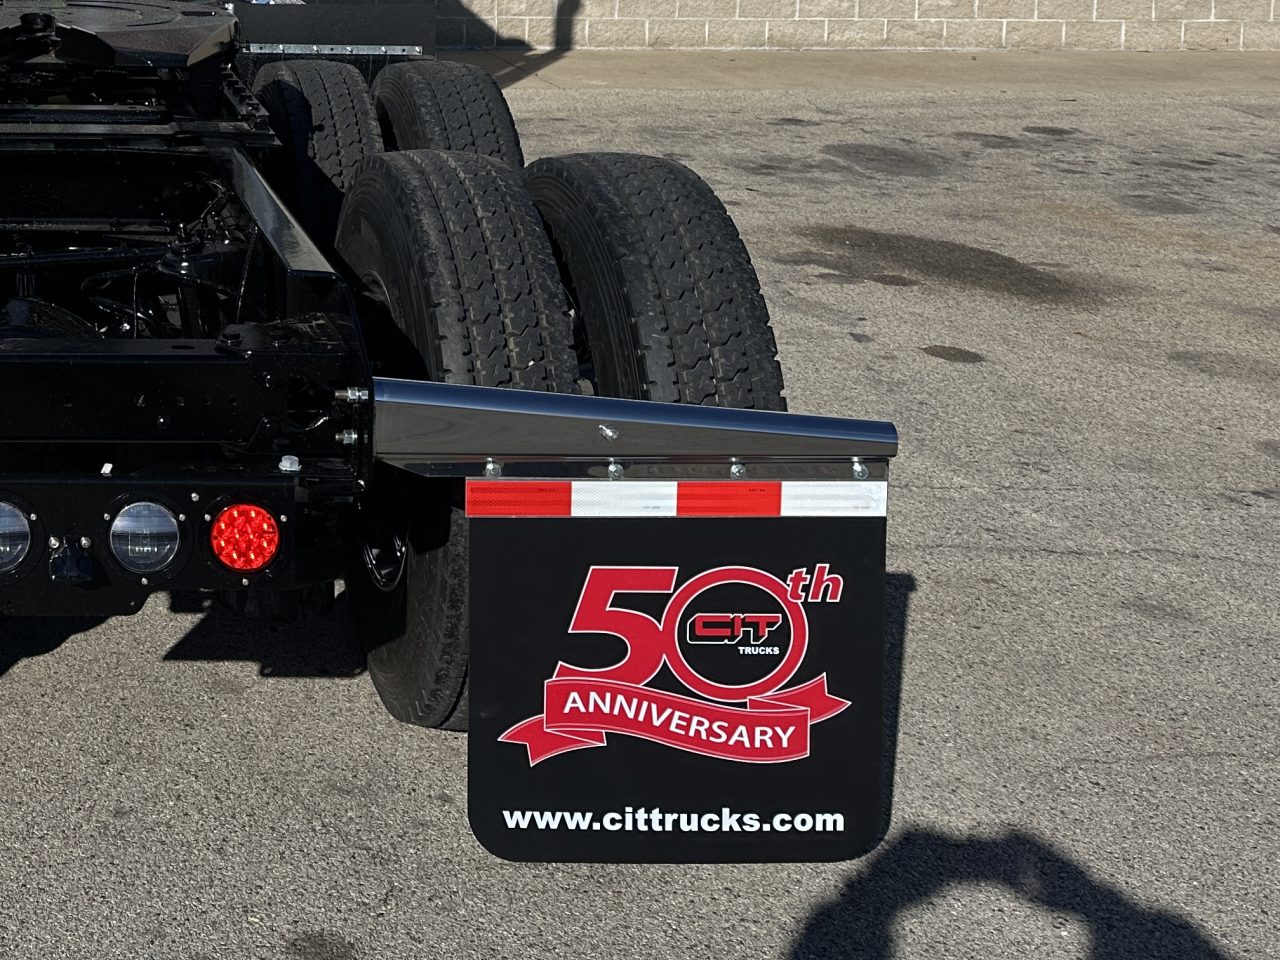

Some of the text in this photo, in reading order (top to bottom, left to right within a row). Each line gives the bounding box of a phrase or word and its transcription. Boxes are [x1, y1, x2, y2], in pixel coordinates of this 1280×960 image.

[686, 613, 782, 644] CIT
[738, 646, 780, 655] TRUCKS
[563, 691, 797, 749] ANNIVERSARY
[502, 807, 845, 833] www.cittrucks.com
